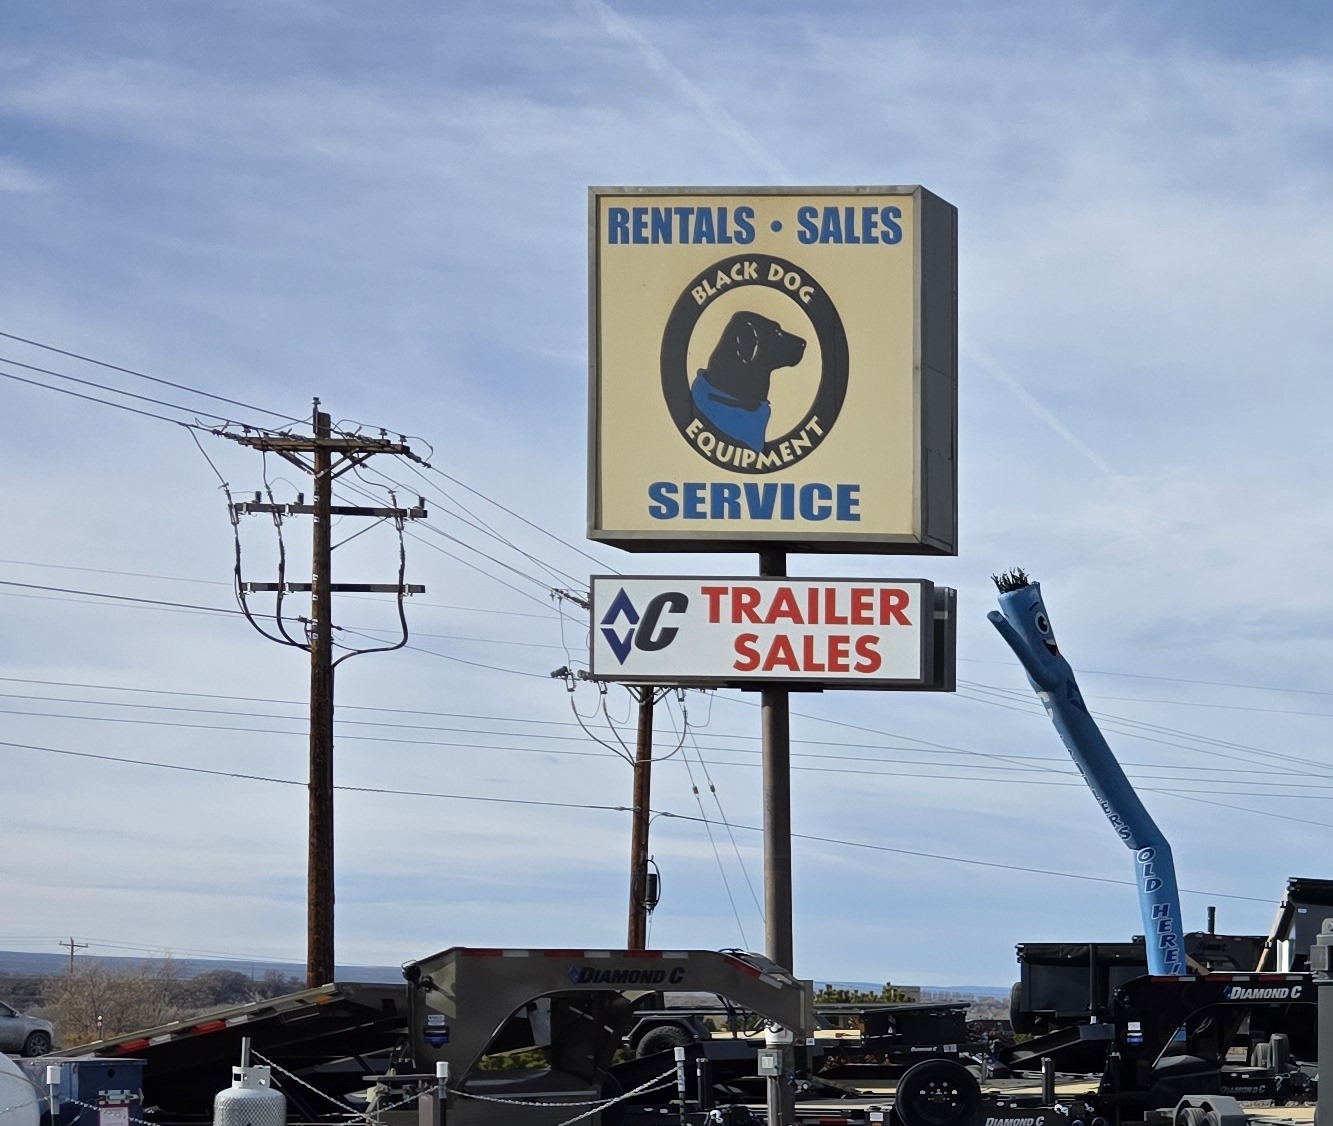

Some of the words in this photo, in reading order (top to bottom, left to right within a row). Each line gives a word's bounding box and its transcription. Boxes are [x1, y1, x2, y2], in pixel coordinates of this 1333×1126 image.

[607, 206, 755, 245] RENTALS
[797, 206, 902, 244] SALES
[691, 261, 759, 305] BLACK
[767, 262, 815, 304] DOG
[685, 416, 825, 470] EQUIPMENT
[648, 481, 861, 522] SERVICE
[634, 591, 689, 652] C
[701, 586, 912, 626] TRAILER
[733, 634, 882, 673] SALES
[1151, 902, 1182, 975] HERE!
[578, 966, 666, 984] DIAMOND
[669, 966, 685, 984] C
[1230, 987, 1289, 1000] DIAMOND
[1290, 985, 1303, 999] C
